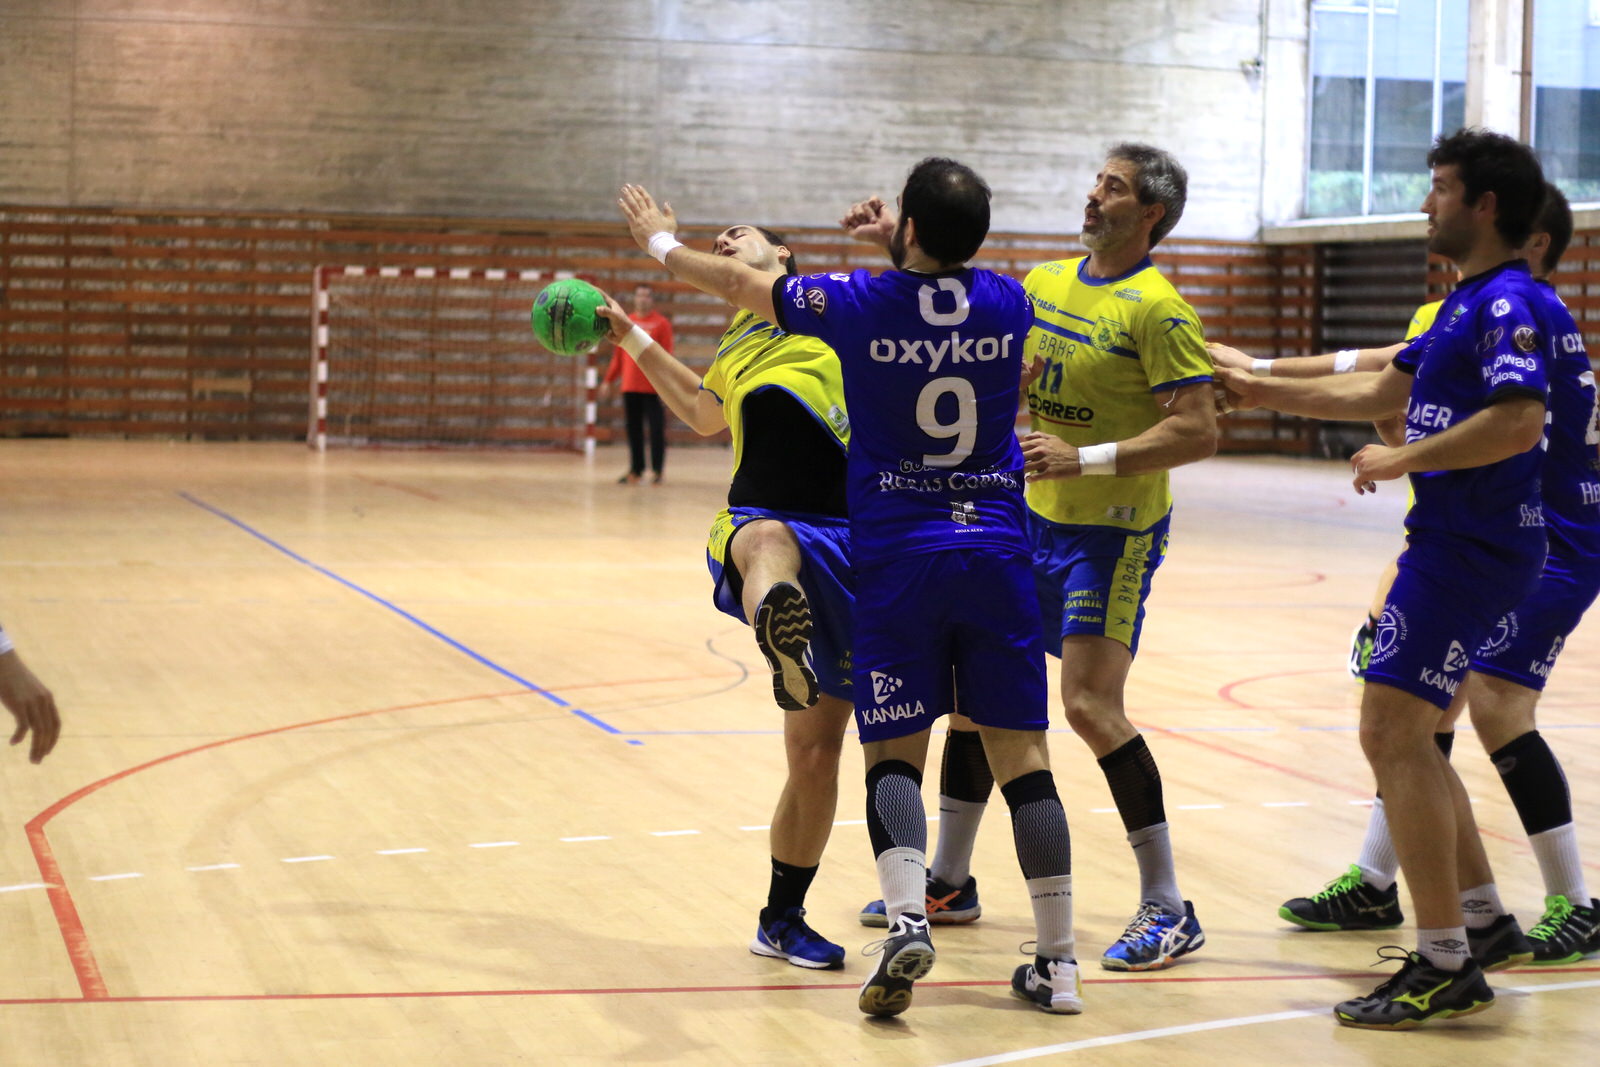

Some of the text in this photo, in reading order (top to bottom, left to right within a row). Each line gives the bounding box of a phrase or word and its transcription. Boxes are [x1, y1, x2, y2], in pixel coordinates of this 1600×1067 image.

[870, 331, 1014, 373] oxykor
[1039, 357, 1064, 394] 11
[915, 376, 978, 468] 9
[861, 700, 926, 726] KANALA
